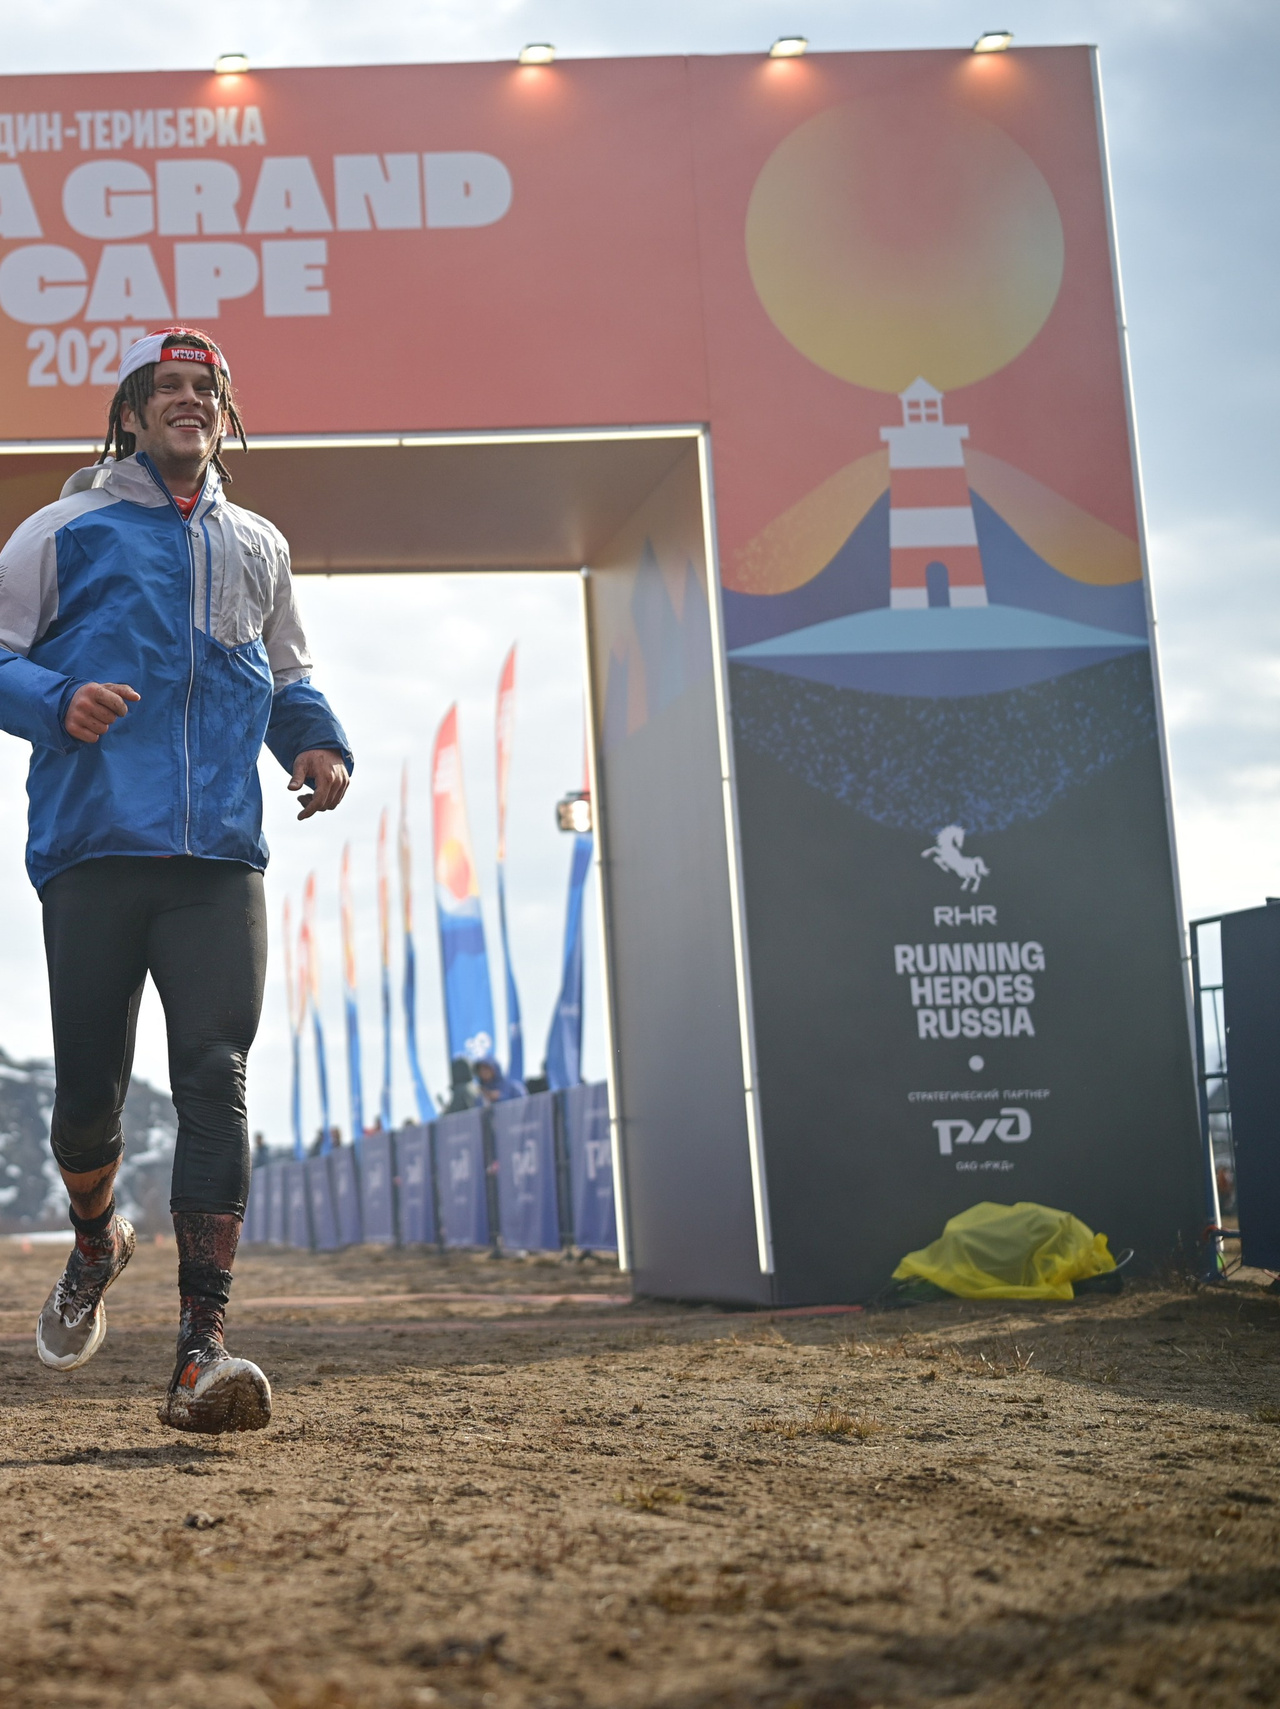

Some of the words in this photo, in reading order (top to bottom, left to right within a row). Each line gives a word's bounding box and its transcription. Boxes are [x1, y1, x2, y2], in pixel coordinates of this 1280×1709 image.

[62, 151, 513, 239] GRAND
[933, 905, 997, 926] RHR
[894, 941, 1046, 974] RUNNING
[910, 974, 1036, 1007] HEROES
[917, 1006, 1036, 1039] RUSSIA
